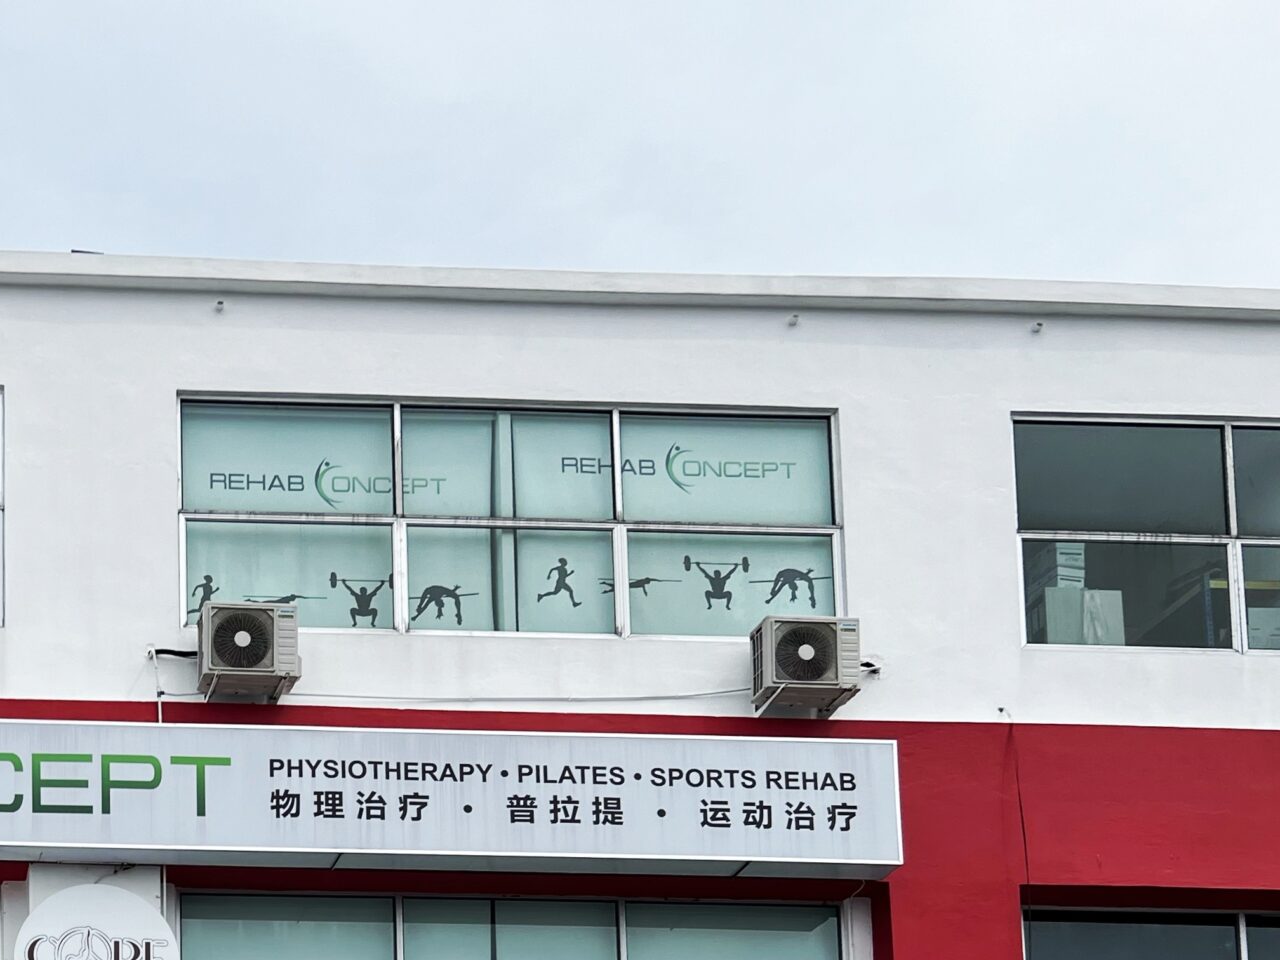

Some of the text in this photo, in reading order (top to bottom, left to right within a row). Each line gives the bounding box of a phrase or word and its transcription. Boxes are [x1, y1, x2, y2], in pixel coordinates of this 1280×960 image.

[561, 457, 656, 476] REHAB
[210, 472, 305, 491] REHAB
[269, 758, 857, 791] PHYSIOTHERAPY PILATES SPORTS REHAB
[270, 789, 858, 832] 物理治疗 普拉提 运动治疗
